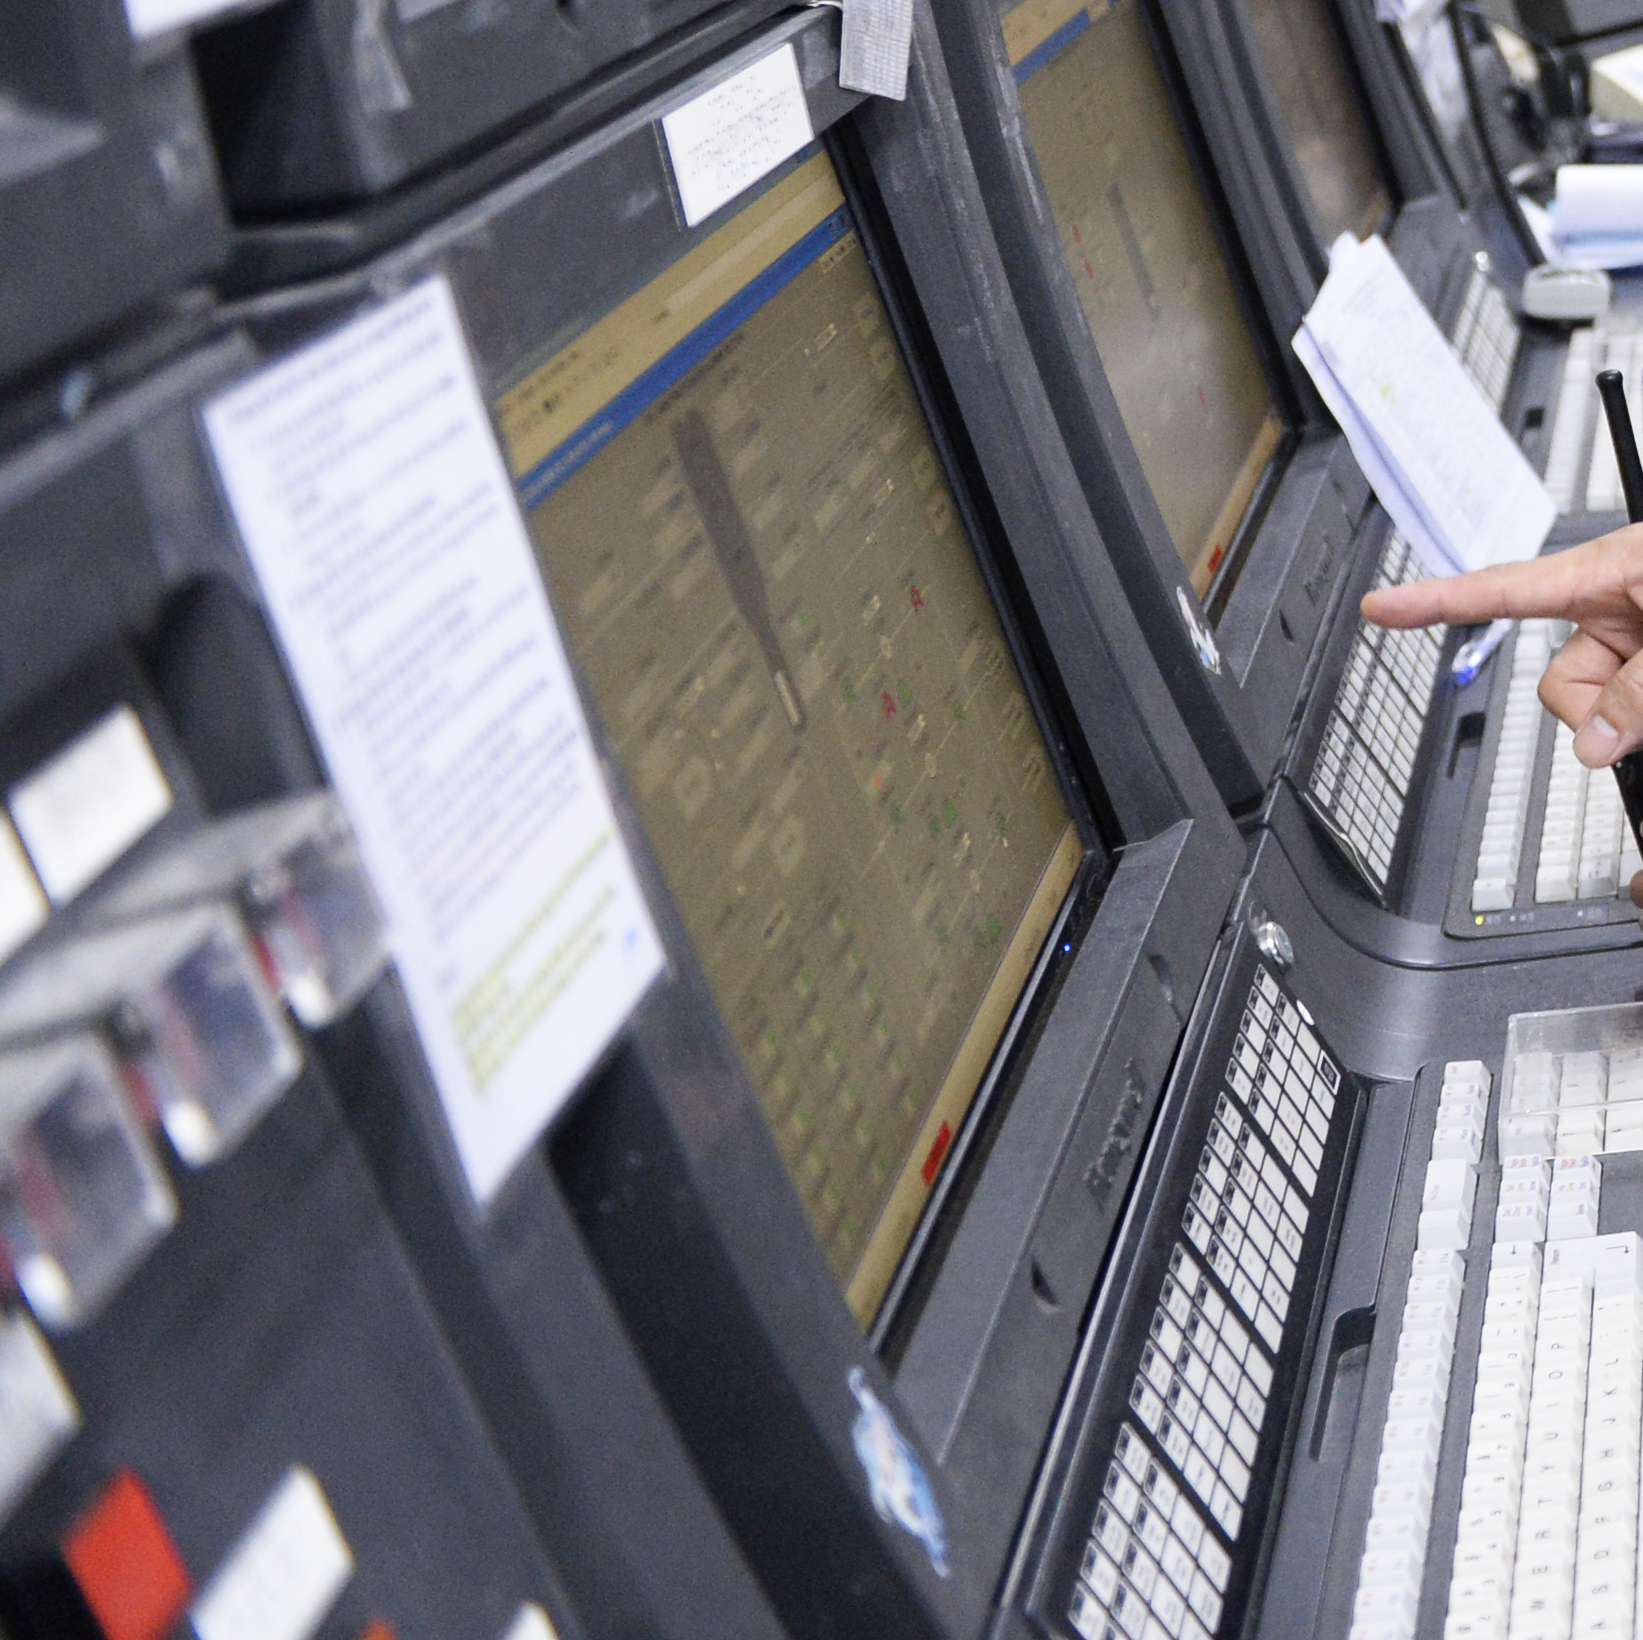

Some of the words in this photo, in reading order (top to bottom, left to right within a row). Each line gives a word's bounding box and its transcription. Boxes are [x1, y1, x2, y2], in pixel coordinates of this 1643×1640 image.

[1551, 1342, 1565, 1350] P
[1605, 1358, 1619, 1367] L
[1548, 1370, 1563, 1380] O
[1602, 1386, 1618, 1397] K
[1601, 1417, 1616, 1425] J
[1544, 1432, 1559, 1441] U
[1600, 1448, 1614, 1459] H
[1540, 1464, 1555, 1473] Y
[1597, 1480, 1613, 1492] G
[1537, 1497, 1552, 1505] T
[1595, 1515, 1610, 1524] F
[1534, 1530, 1550, 1540] R
[1594, 1550, 1609, 1560] D
[1531, 1565, 1548, 1575] E
[1591, 1584, 1608, 1595] S
[1530, 1597, 1545, 1612] W
[1591, 1621, 1605, 1631] A
